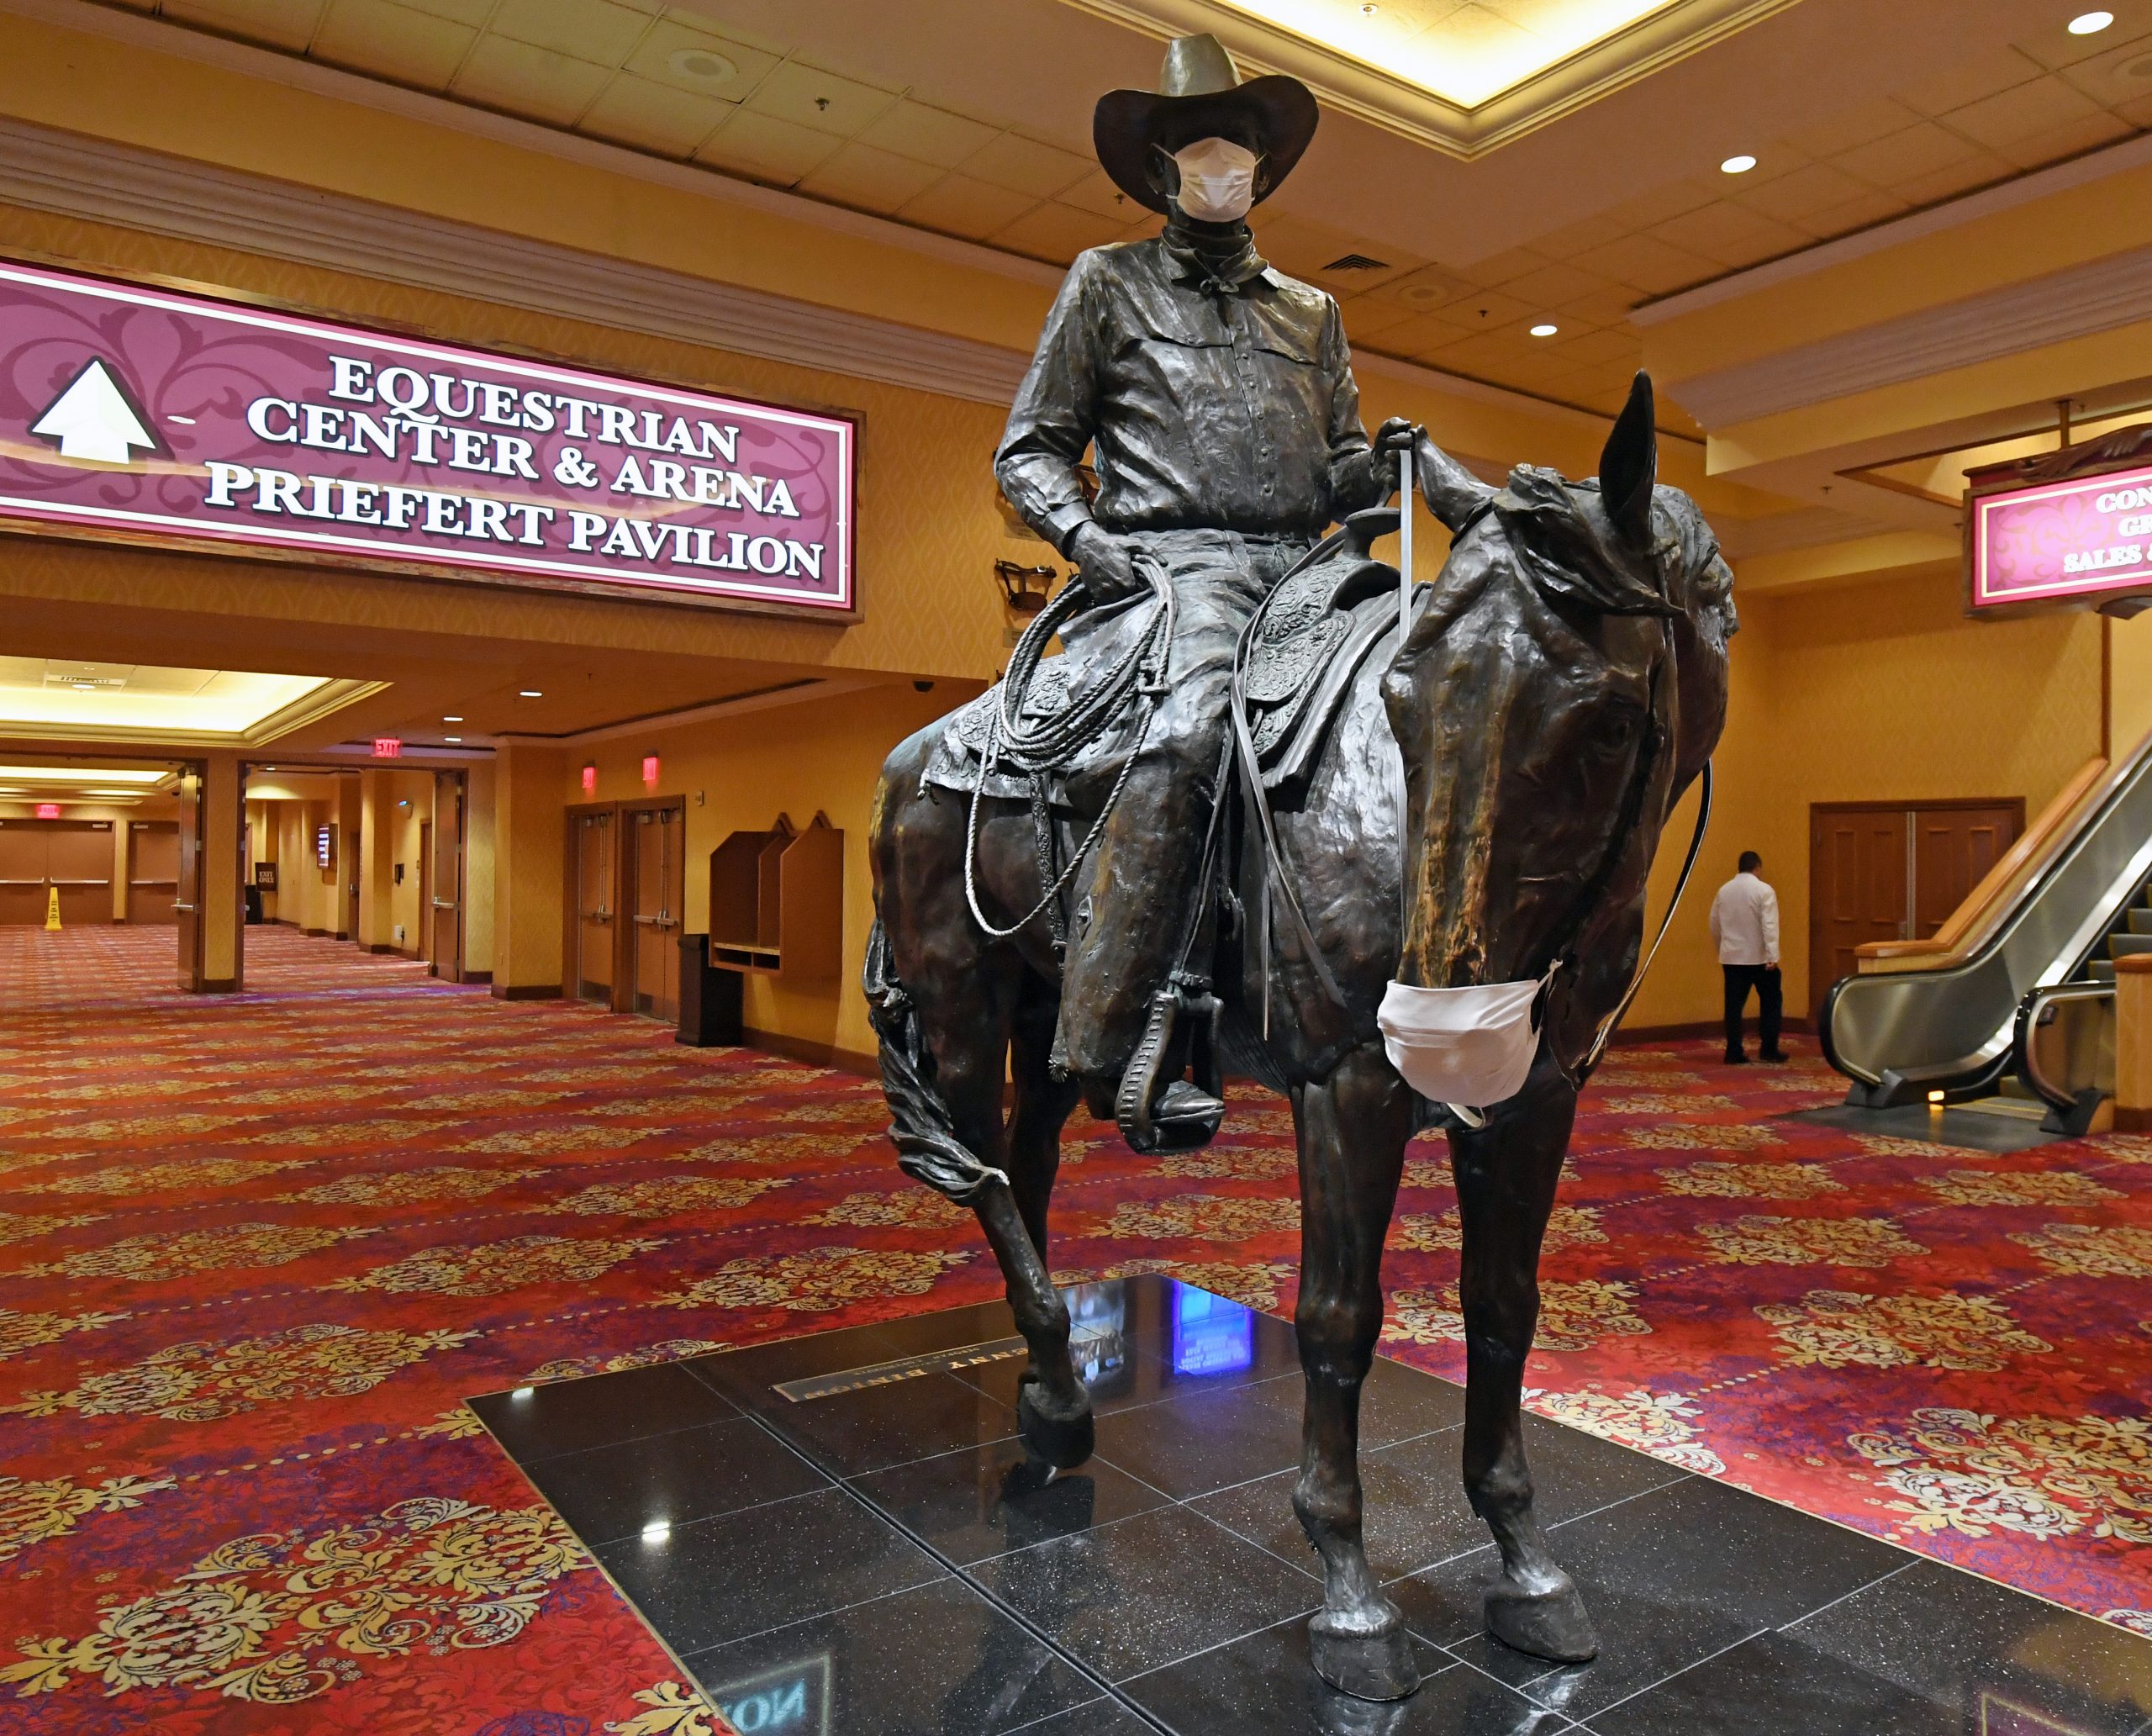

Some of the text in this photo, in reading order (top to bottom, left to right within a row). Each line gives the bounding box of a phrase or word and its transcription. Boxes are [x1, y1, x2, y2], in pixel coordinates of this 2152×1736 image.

[329, 356, 739, 462] EQUESTRIAN
[247, 398, 800, 518] CENTER & ARENA
[204, 461, 824, 580] PRIEFERT PAVILION
[2064, 545, 2143, 573] SALES
[375, 740, 400, 757] EXIT
[950, 1347, 1029, 1370] ENNY
